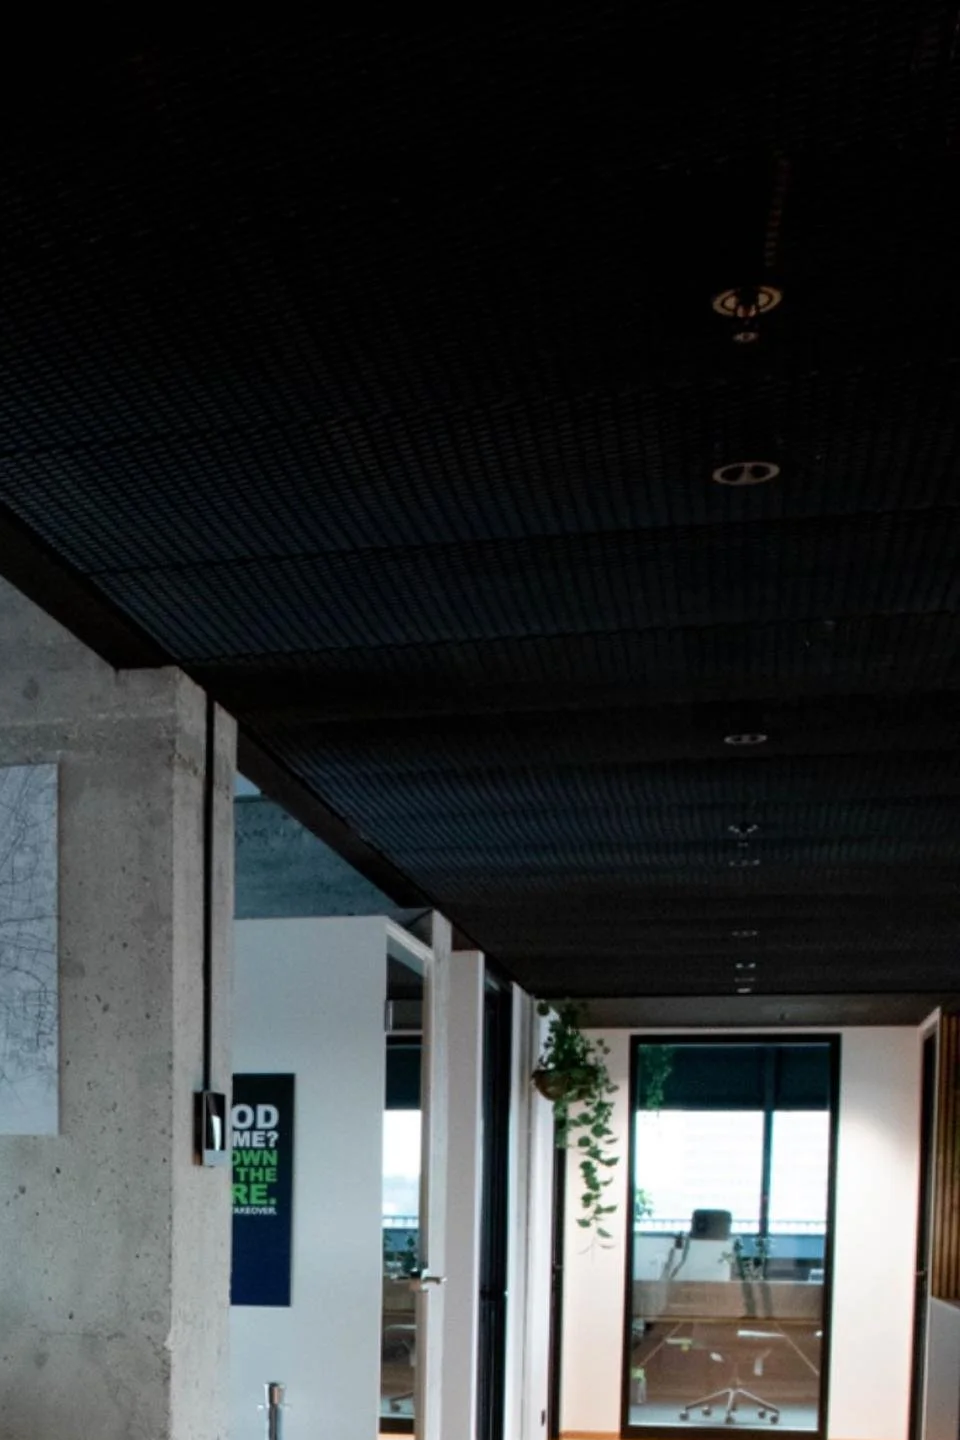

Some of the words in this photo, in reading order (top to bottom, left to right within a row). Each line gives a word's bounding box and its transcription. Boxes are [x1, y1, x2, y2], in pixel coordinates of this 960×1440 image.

[231, 1103, 279, 1129] OD
[233, 1130, 279, 1147] ME?
[236, 1167, 277, 1182] THE
